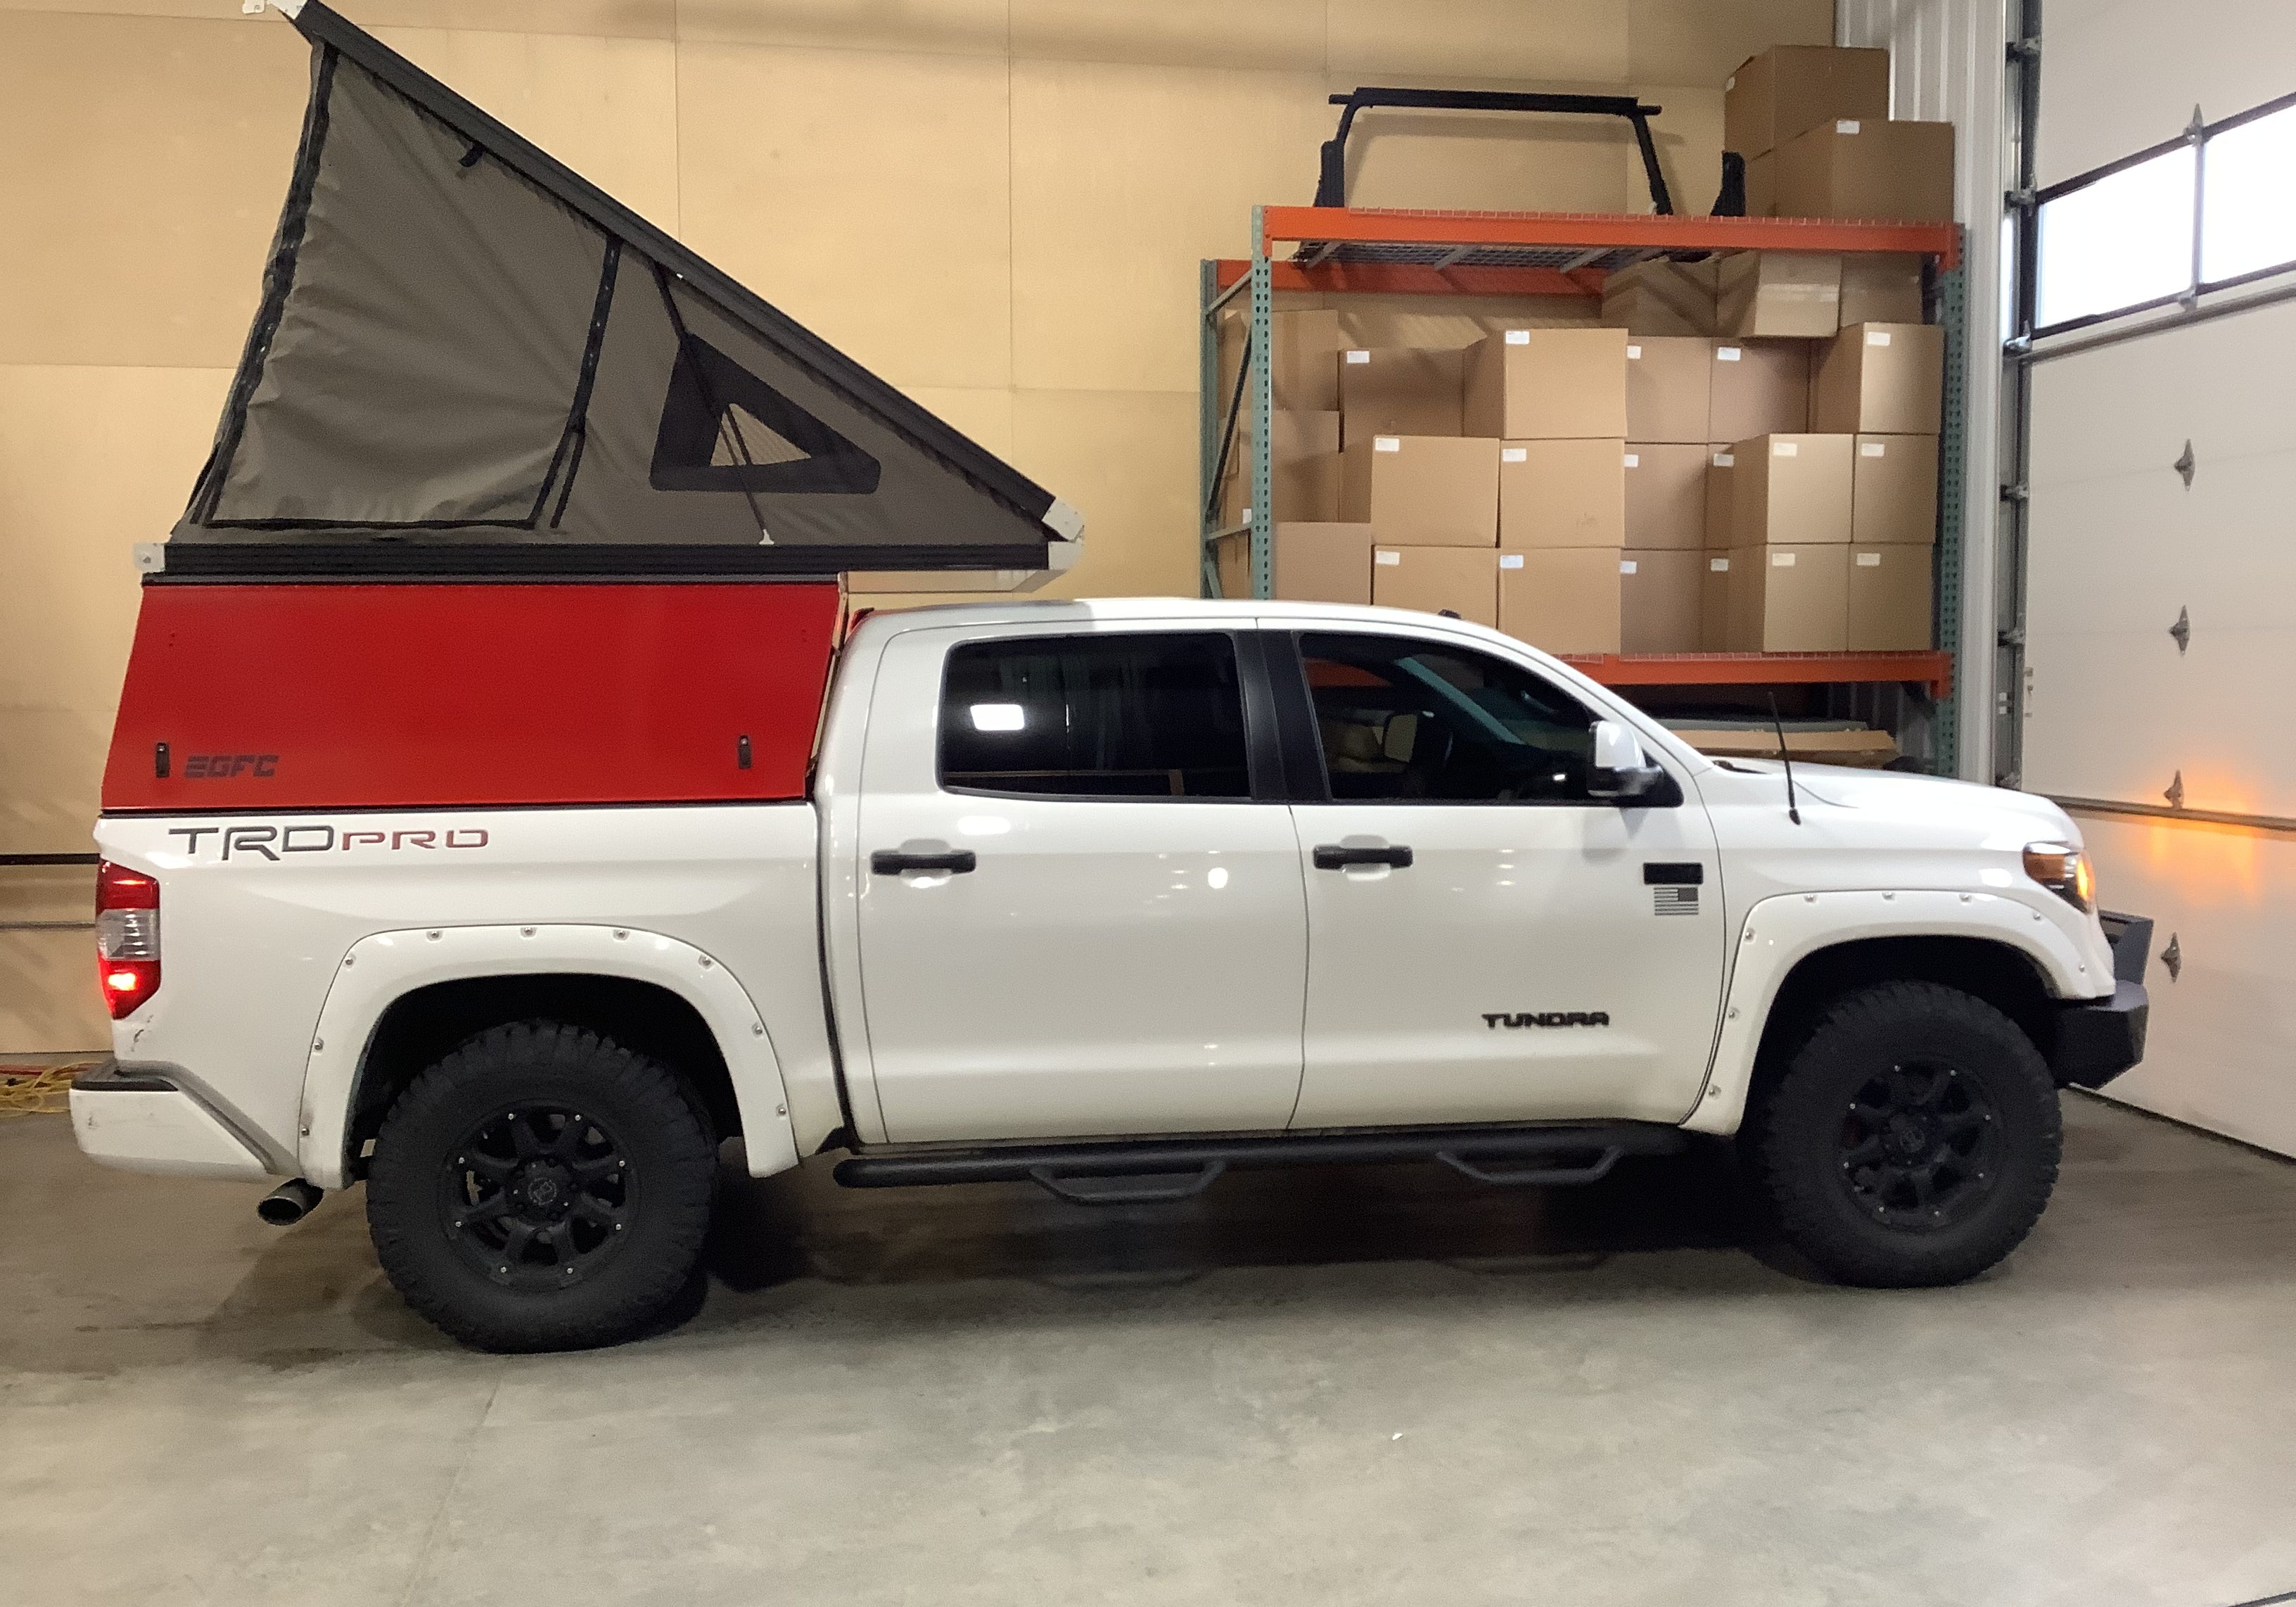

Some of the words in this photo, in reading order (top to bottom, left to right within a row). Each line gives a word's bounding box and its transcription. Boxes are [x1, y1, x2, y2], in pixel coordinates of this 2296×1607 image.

[168, 825, 335, 861] TRD
[341, 829, 490, 851] PRO
[1481, 1012, 1609, 1028] TUNDRA
